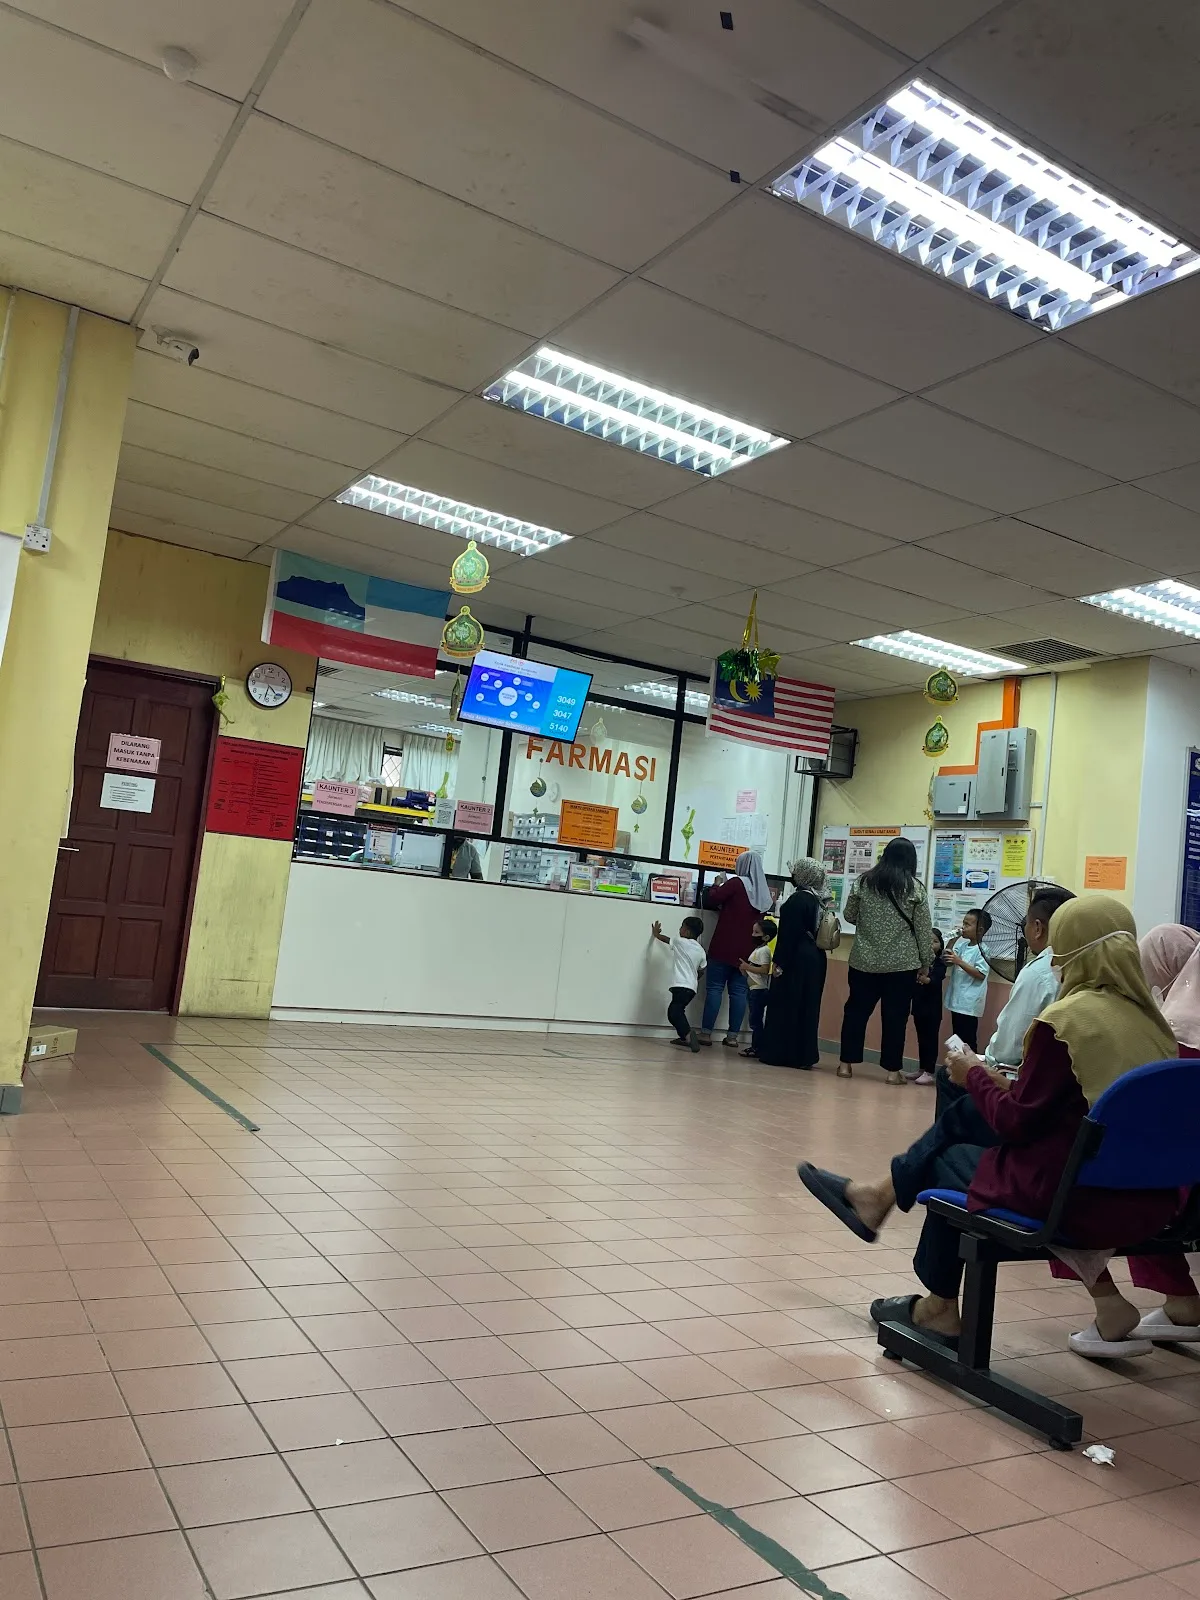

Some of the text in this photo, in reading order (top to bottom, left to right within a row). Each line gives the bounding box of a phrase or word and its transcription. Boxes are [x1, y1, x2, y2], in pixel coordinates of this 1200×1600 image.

[556, 696, 576, 706] 3049
[552, 709, 572, 719] 3047
[549, 722, 568, 732] 5140
[120, 740, 150, 750] DILARANG
[114, 748, 135, 756] MASUK
[116, 756, 150, 766] KEBENARAN
[526, 736, 656, 782] FARMASI
[320, 784, 349, 794] KAUNTER
[460, 804, 486, 812] KAUNTER
[710, 845, 734, 854] KAUNTER
